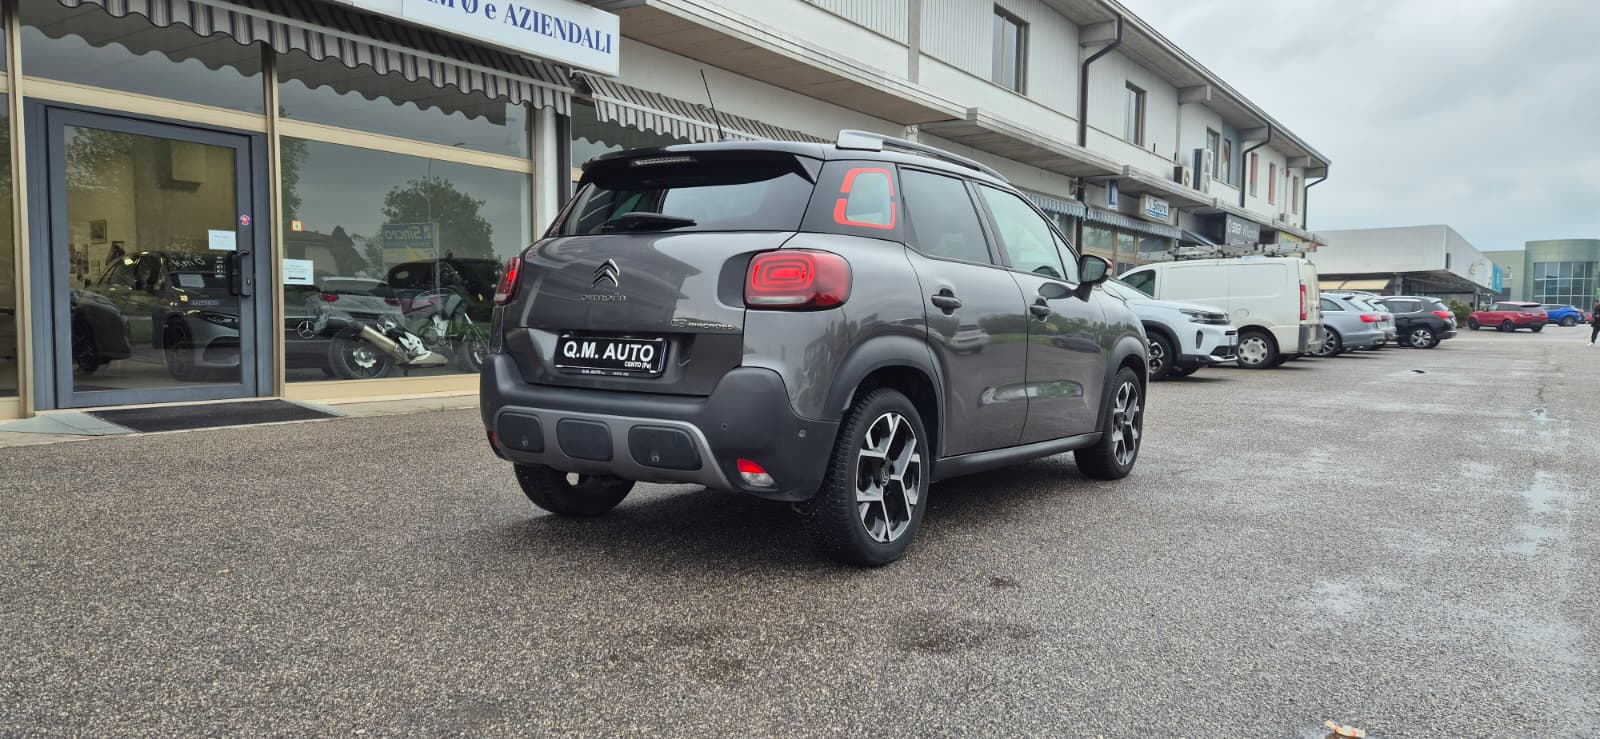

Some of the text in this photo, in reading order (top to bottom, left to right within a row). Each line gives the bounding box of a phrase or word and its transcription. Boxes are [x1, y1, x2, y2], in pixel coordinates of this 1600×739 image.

[484, 3, 497, 20] e
[503, 3, 611, 54] AZIENDALI
[563, 340, 655, 363] Q.M. AUTO
[624, 360, 642, 368] CENTO
